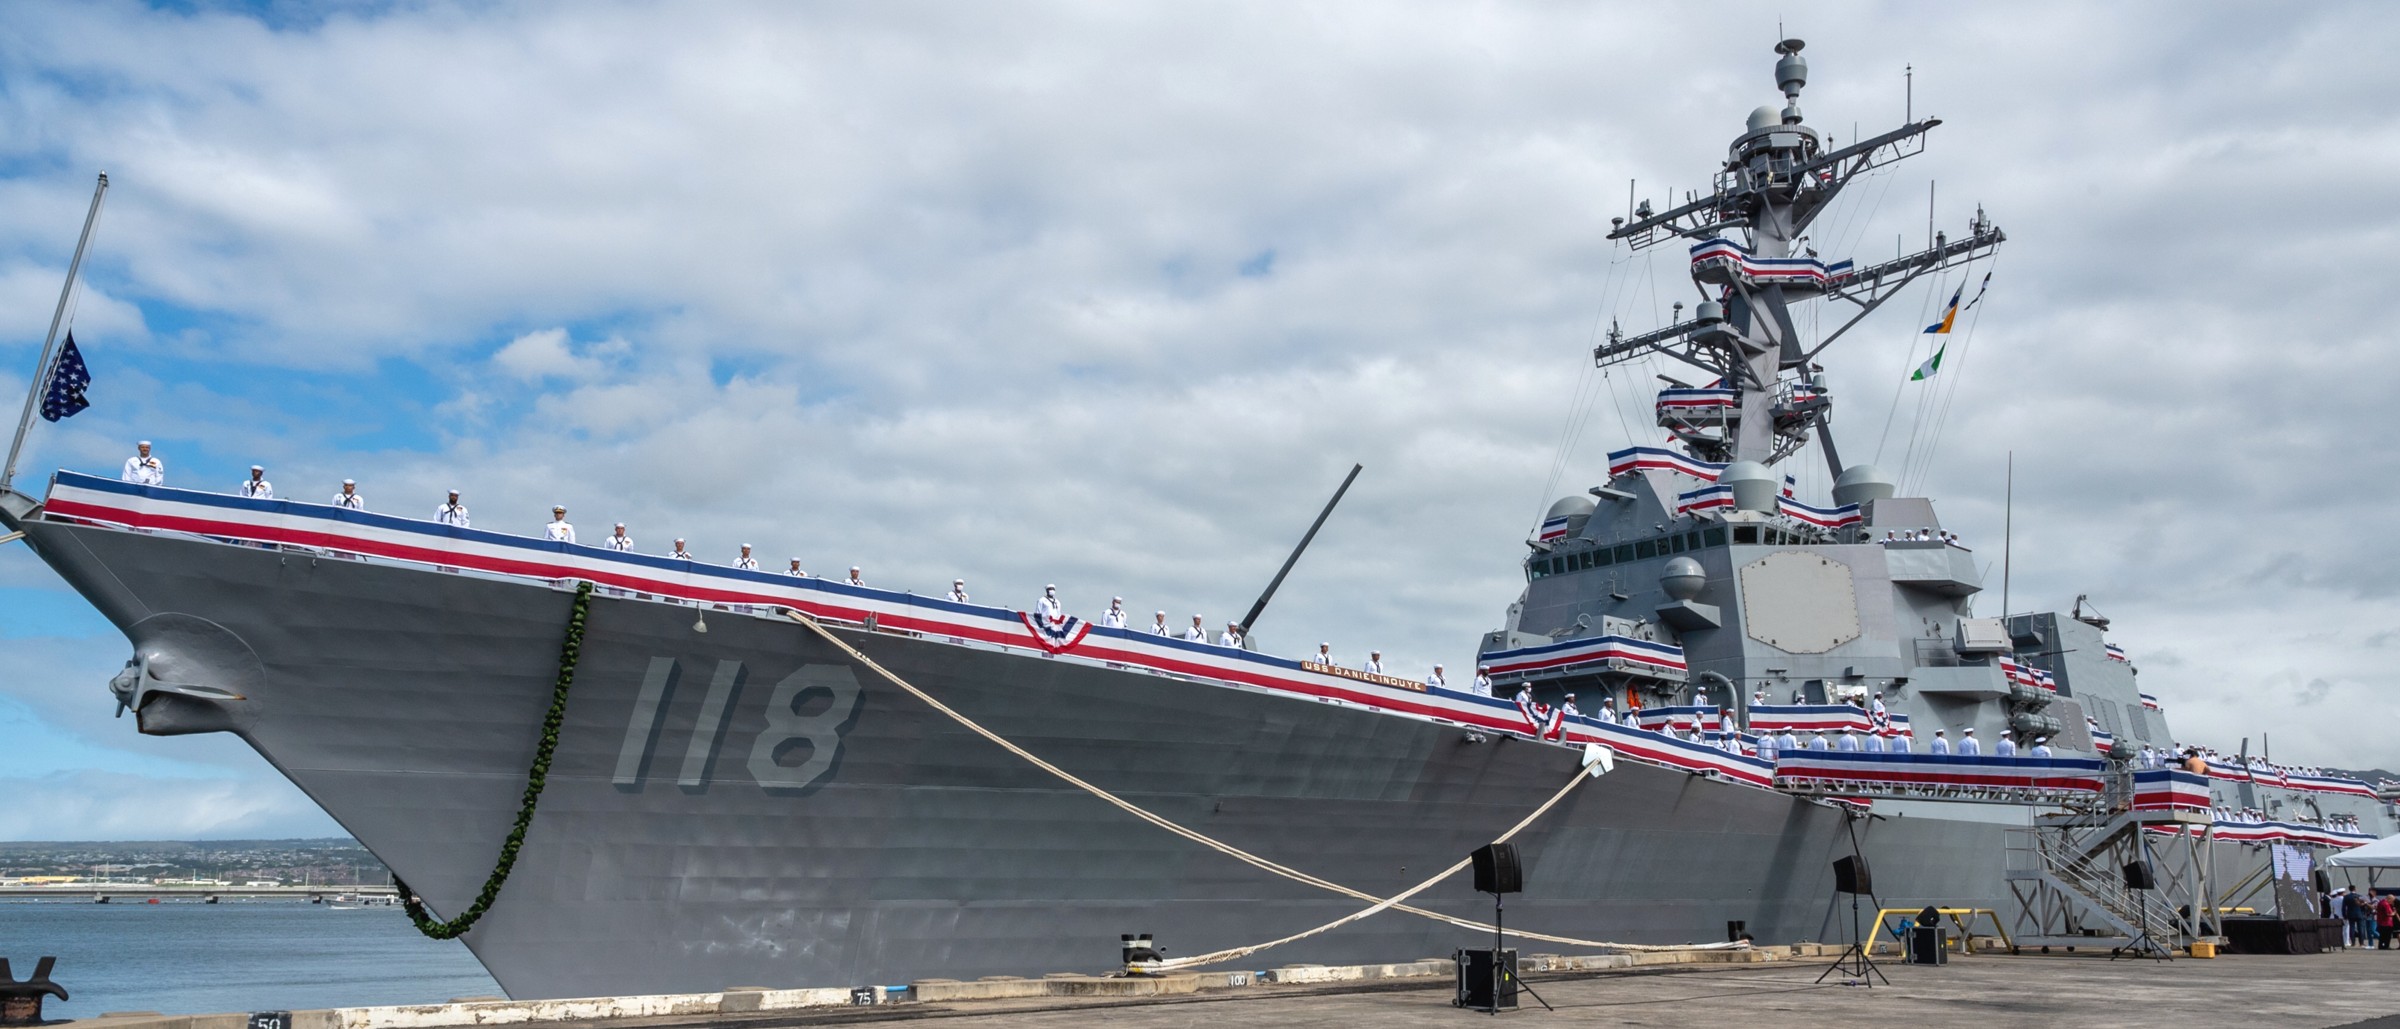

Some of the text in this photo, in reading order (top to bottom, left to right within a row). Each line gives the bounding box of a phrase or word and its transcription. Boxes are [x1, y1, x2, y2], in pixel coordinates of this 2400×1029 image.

[1304, 661, 1422, 691] USS DANIEL INOUYE
[612, 656, 864, 793] 118
[1230, 975, 1246, 986] 100
[857, 992, 871, 1006] 75
[257, 1018, 281, 1029] 50
